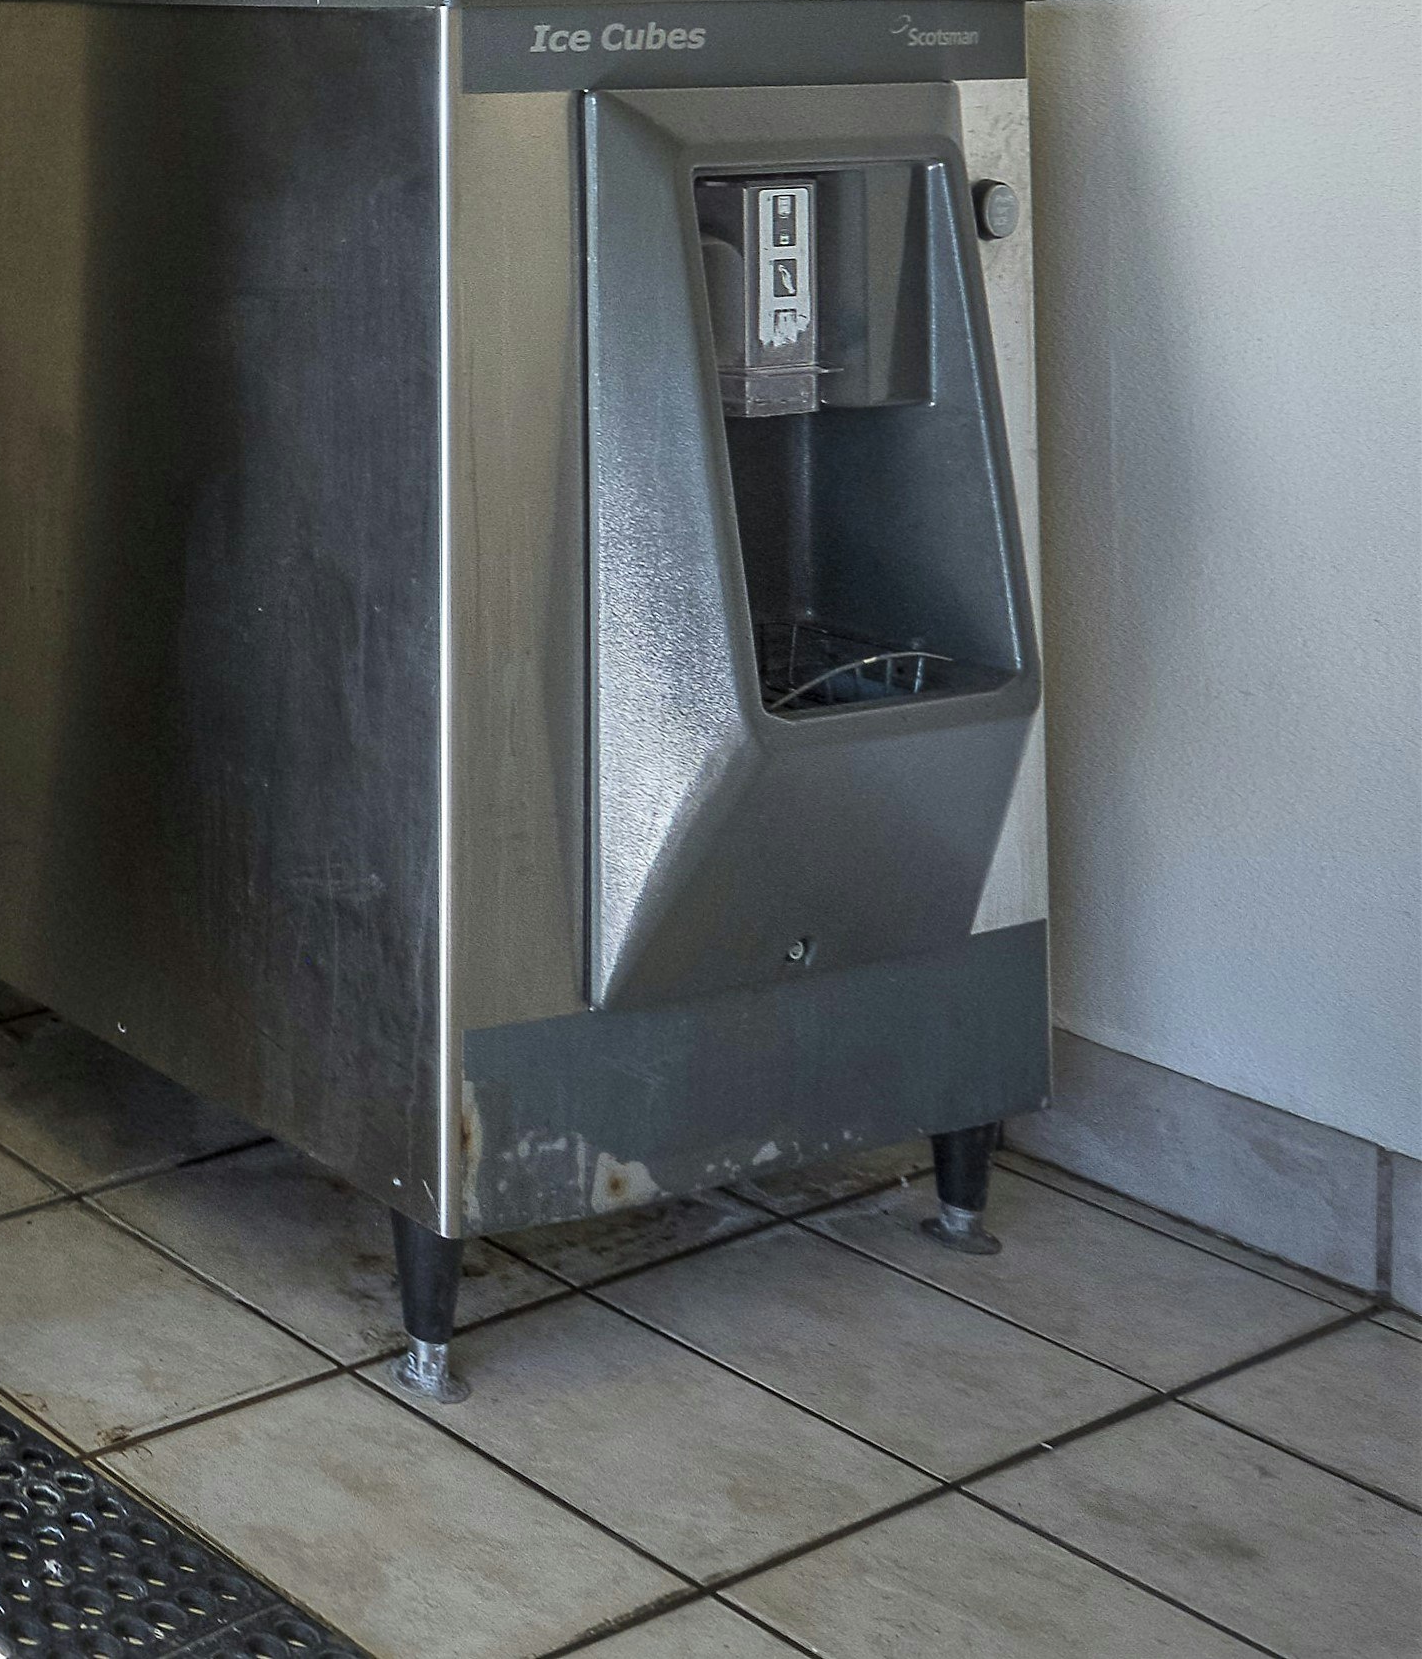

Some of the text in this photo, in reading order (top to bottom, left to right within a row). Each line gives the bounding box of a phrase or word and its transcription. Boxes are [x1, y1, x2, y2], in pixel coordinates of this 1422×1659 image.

[530, 22, 706, 53] Ice Cubes
[907, 28, 979, 47] Scotsman
